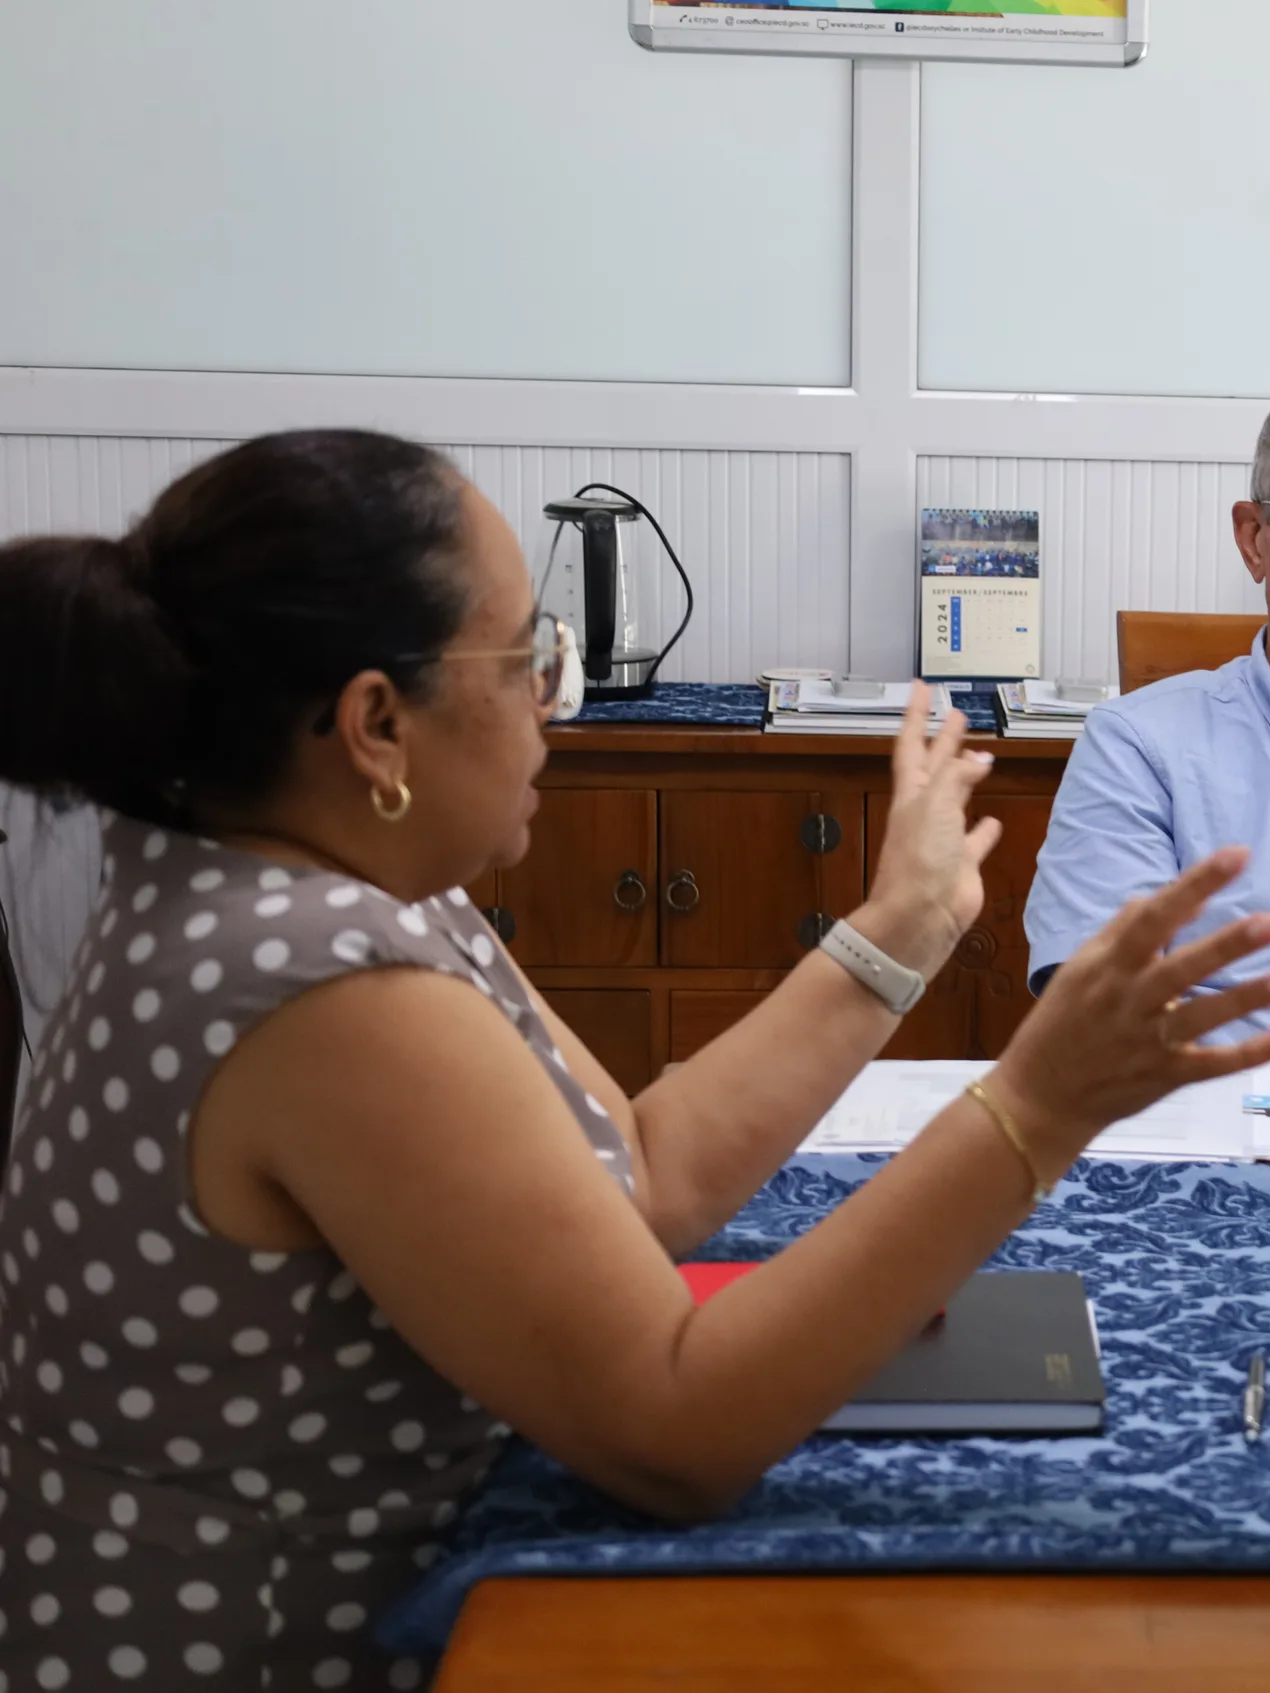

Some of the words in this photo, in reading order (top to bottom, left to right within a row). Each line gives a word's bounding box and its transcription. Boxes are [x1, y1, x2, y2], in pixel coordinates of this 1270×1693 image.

[1005, 27, 1022, 36] Early
[1023, 27, 1058, 36] Childhood
[1059, 29, 1104, 38] Development
[937, 604, 948, 644] 2024
